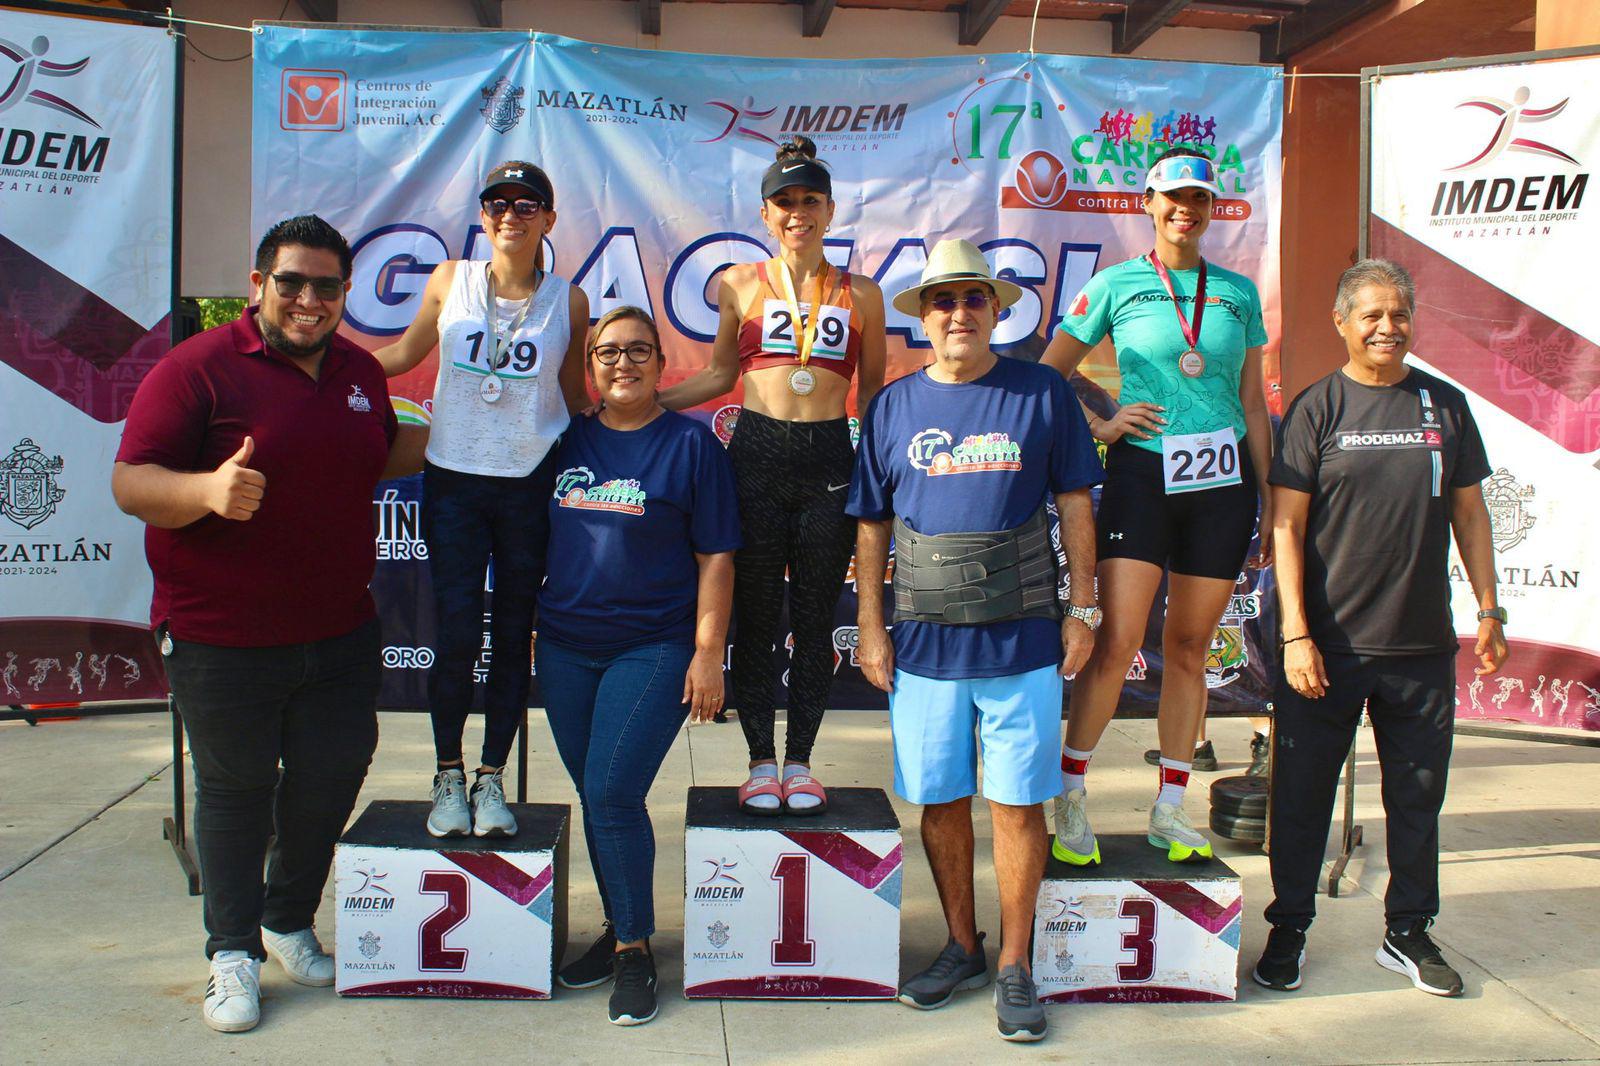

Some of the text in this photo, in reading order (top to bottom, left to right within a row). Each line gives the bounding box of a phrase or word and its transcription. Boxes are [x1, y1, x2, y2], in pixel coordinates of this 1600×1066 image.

[355, 79, 432, 91] Centros de
[354, 96, 437, 111] Integración
[536, 89, 688, 122] MAZATLÁN
[352, 113, 445, 127] Juvenil, A.C.
[586, 114, 638, 125] 2021-2024
[780, 103, 908, 133] IMDEM
[0, 128, 110, 172] DEM
[42, 172, 58, 180] DEL
[60, 173, 101, 184] DEPORTE
[1431, 173, 1589, 216] IMDEM
[1078, 196, 1132, 210] contra
[1429, 212, 1578, 227] INSTITUTO MUNICIPAL DEL DEPORTE
[1453, 226, 1551, 239] MAZATLÁN
[1341, 432, 1425, 447] PRODEMAZ
[1171, 443, 1235, 482] 220
[694, 887, 744, 899] IMDEM
[344, 897, 395, 909] IMDEM
[770, 853, 815, 966] 1
[418, 870, 470, 973] 2
[1045, 921, 1087, 932] IMDEM
[1115, 898, 1158, 983] 3
[693, 951, 744, 960] MAZATLÁN
[344, 962, 395, 970] MAZATLÁN
